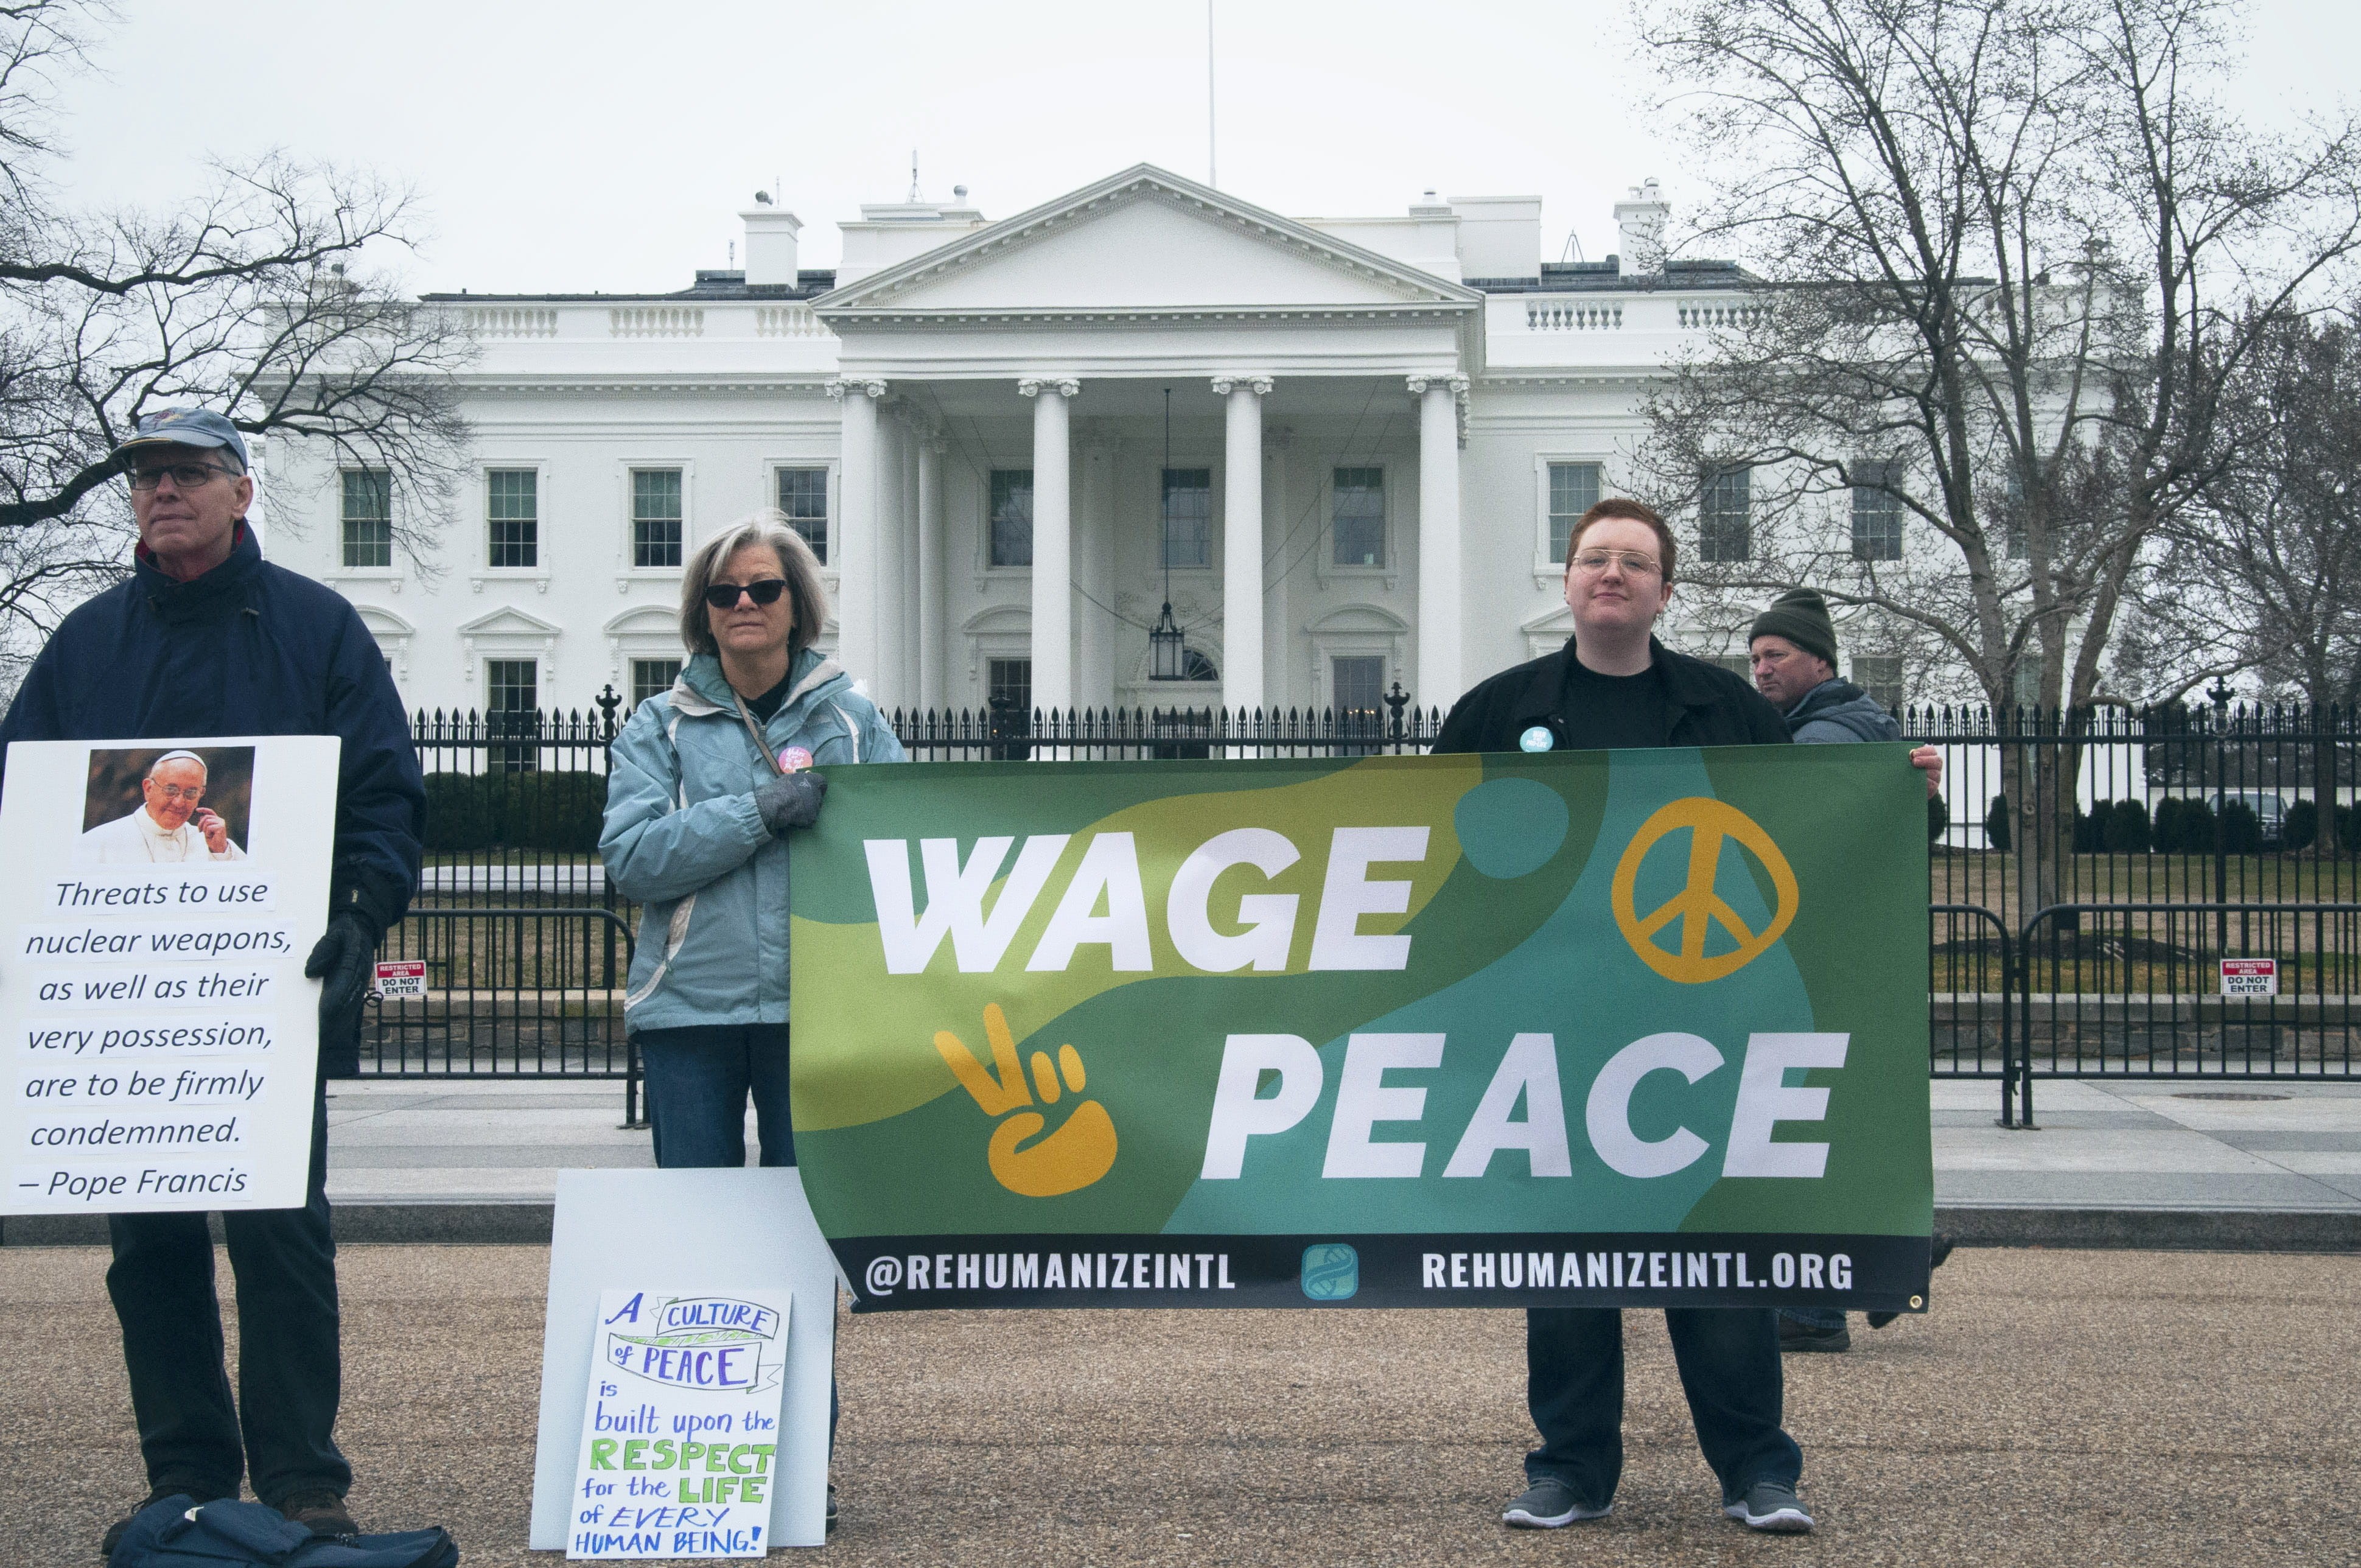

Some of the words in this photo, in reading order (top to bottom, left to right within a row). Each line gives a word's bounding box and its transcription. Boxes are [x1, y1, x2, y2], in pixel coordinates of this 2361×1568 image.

[58, 883, 168, 906] Threats
[180, 883, 208, 903] to
[220, 886, 268, 903] use
[863, 826, 1432, 976] WAGE
[27, 929, 142, 954] nuclear
[153, 933, 290, 956] weapons,
[41, 984, 73, 1001] as
[86, 975, 147, 1000] well
[156, 981, 187, 999] as
[200, 974, 269, 998] their
[30, 1032, 93, 1055] very
[101, 1023, 271, 1054] possession,
[27, 1080, 77, 1097] are
[89, 1075, 118, 1096] to
[129, 1071, 166, 1096] be
[169, 1070, 264, 1102] firmly
[1201, 1034, 1850, 1180] PEACE
[32, 1118, 239, 1146] condemnned.
[49, 1172, 127, 1201] Pope
[138, 1169, 247, 1194] Francis
[867, 1255, 1235, 1295] @REHUMANIZEINTL
[1424, 1254, 1852, 1289] REHUMANIZEINTL.ORG
[606, 1293, 643, 1325] A
[668, 1304, 770, 1331] CULTURE
[616, 1346, 633, 1365] of
[644, 1348, 748, 1386] PEACE
[601, 1382, 617, 1397] is
[595, 1402, 659, 1433] built
[673, 1415, 733, 1443] upon
[742, 1412, 775, 1432] the
[590, 1438, 775, 1473] RESPECT
[582, 1478, 616, 1499] for
[628, 1478, 670, 1498] the
[679, 1477, 766, 1503] LIFE
[580, 1505, 604, 1524] of
[609, 1508, 730, 1528] EVERY
[576, 1533, 662, 1555] HUMAN
[674, 1525, 763, 1554] BEING!
